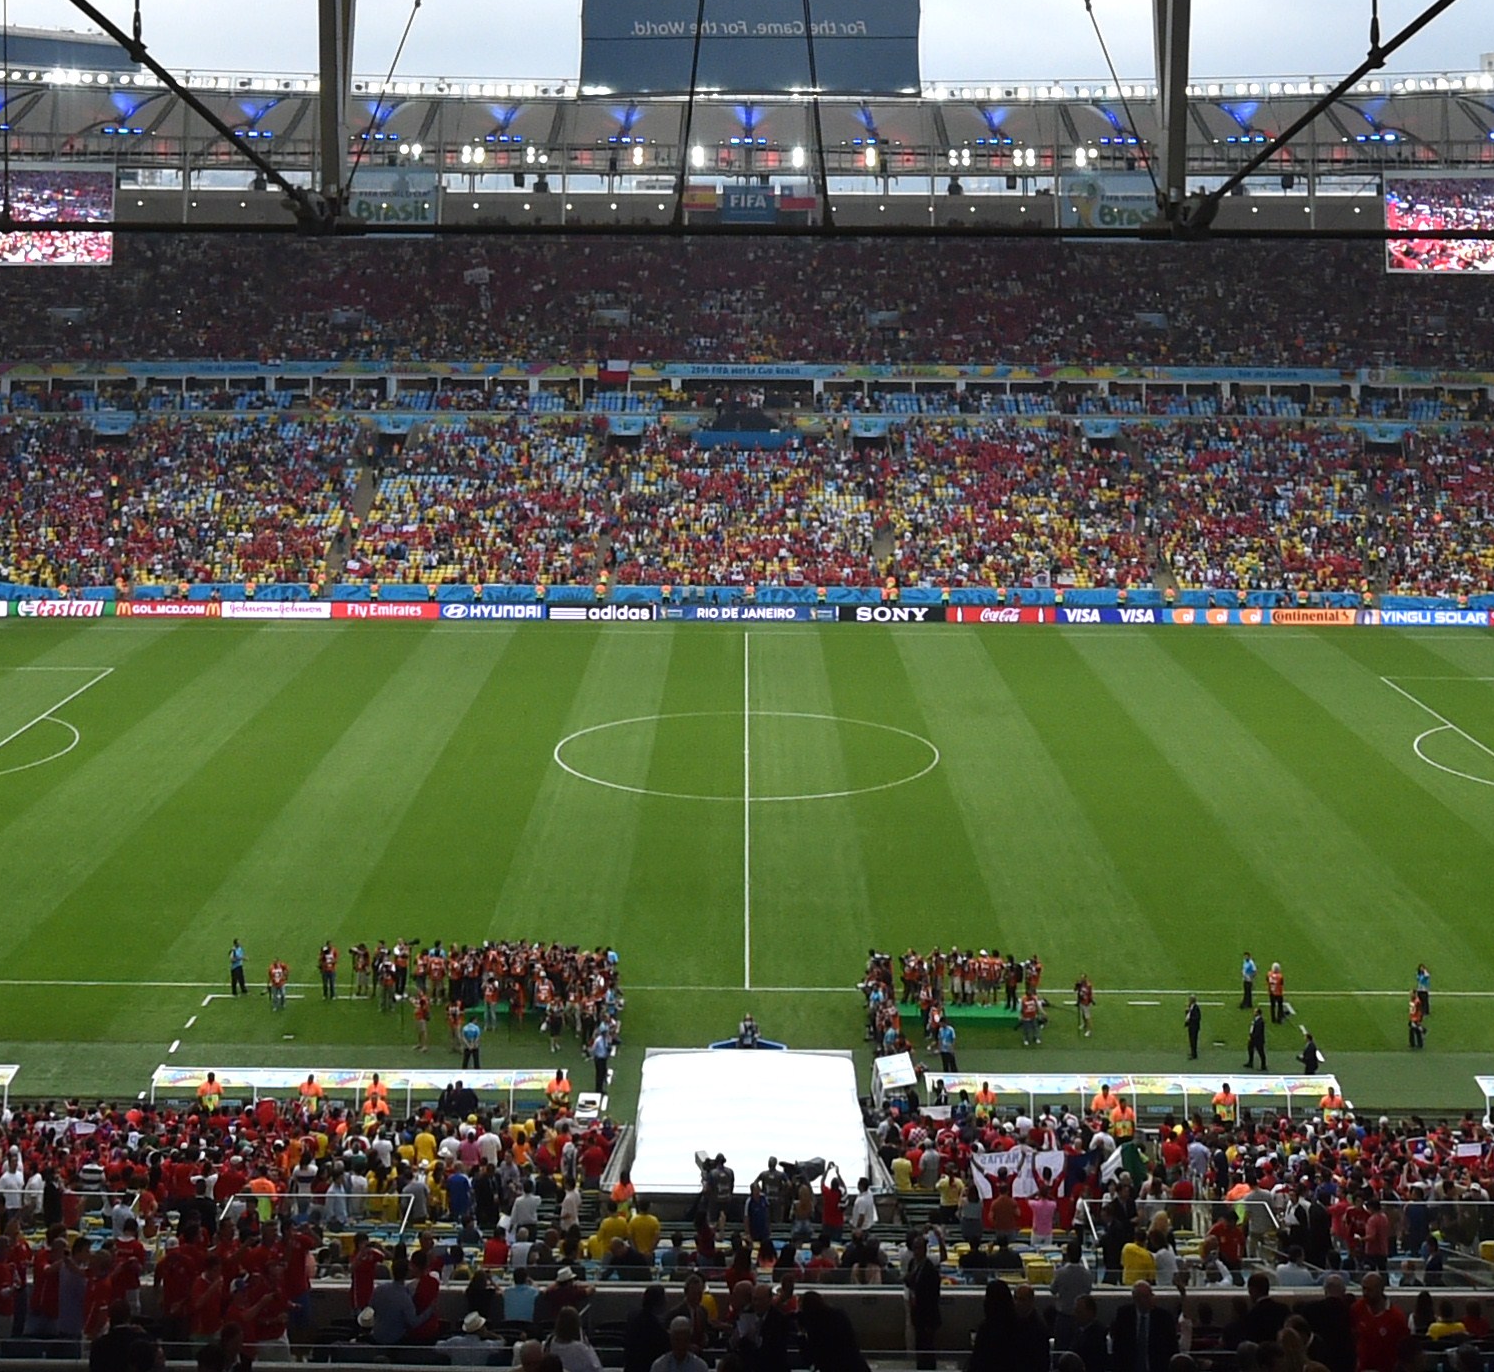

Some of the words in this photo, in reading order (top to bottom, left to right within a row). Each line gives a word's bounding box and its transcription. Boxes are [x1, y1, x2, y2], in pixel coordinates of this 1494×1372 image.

[730, 194, 766, 208] FIFA
[37, 600, 103, 616] Castrol
[347, 603, 367, 617] Fly
[370, 603, 421, 616] Emirates
[469, 604, 542, 617] HYUNDAI
[588, 604, 650, 619] adidas
[696, 607, 720, 619] RIO
[722, 607, 739, 619] DE
[741, 607, 796, 619] JANEIRO
[856, 607, 929, 621] SONY
[1063, 608, 1100, 622] VISA
[1117, 608, 1155, 623] VISA
[1273, 610, 1339, 622] Continental
[1434, 610, 1487, 625] SOLAR
